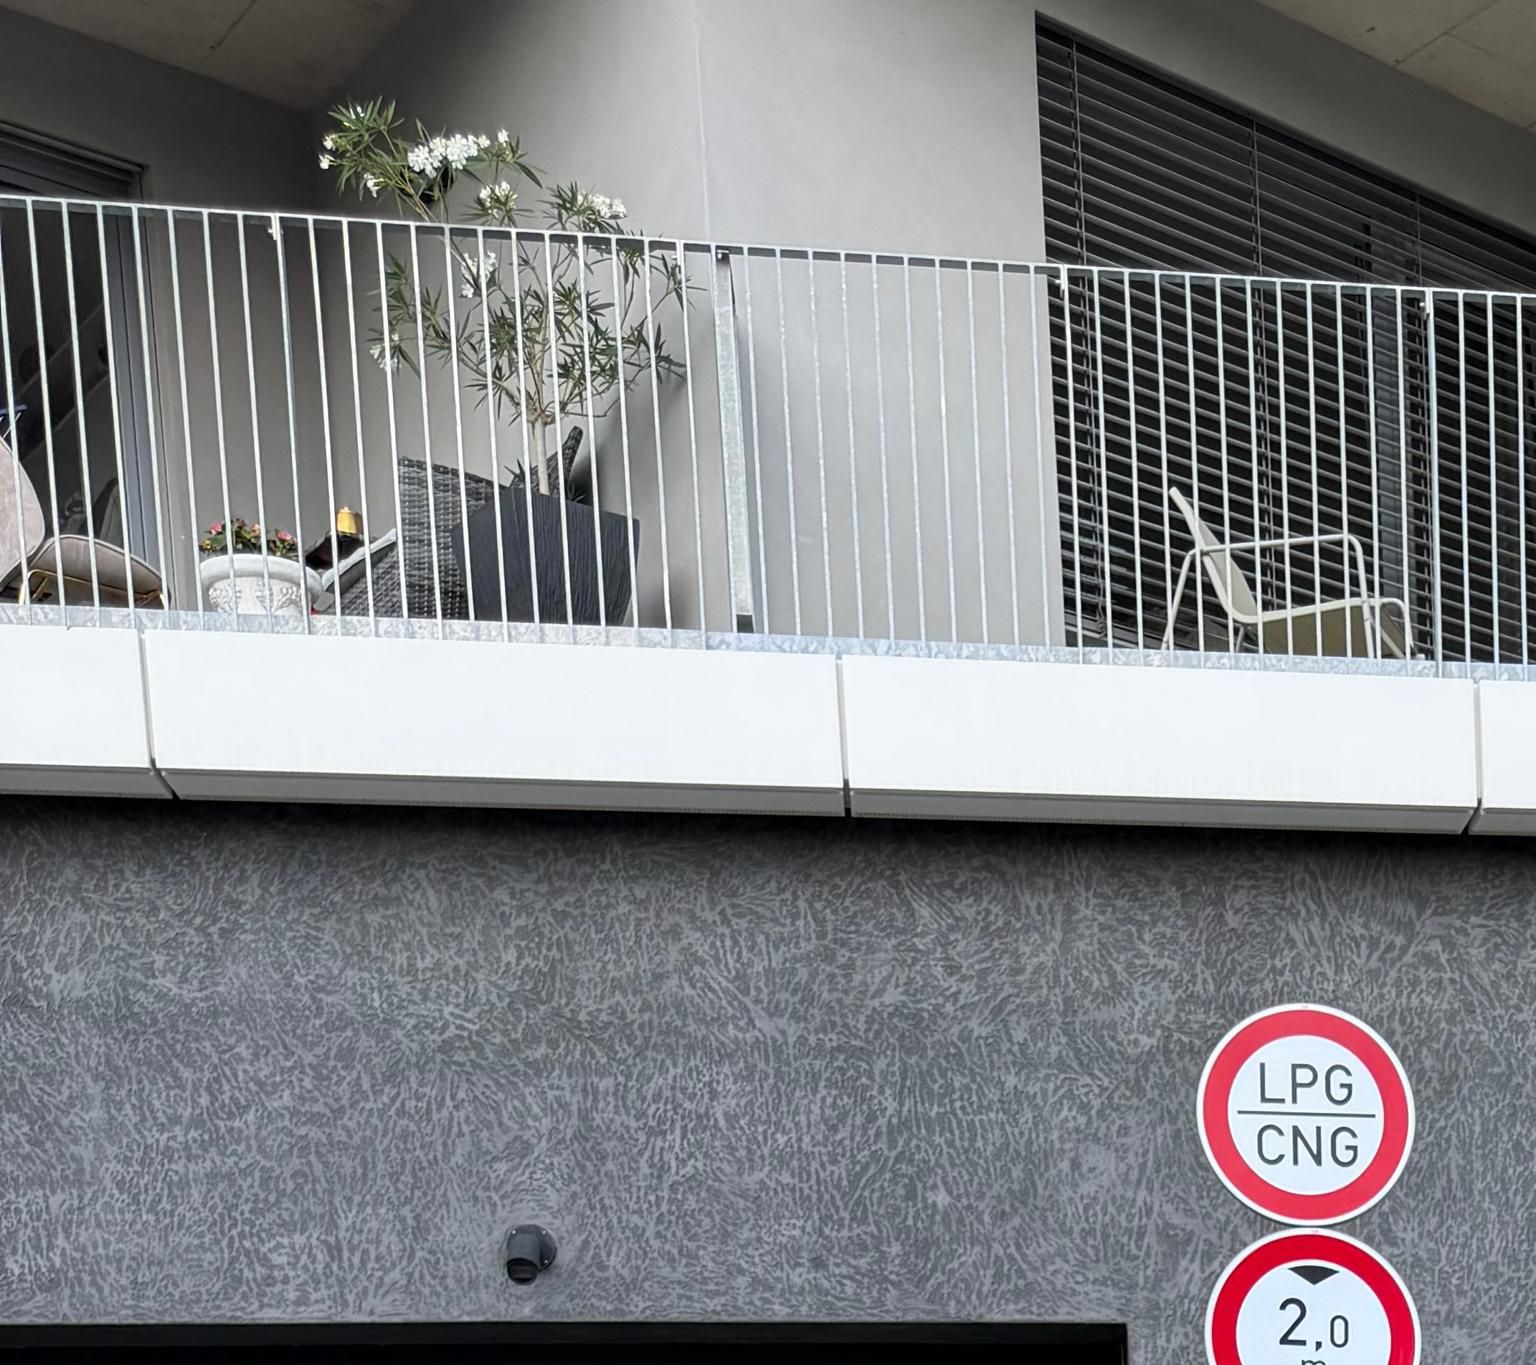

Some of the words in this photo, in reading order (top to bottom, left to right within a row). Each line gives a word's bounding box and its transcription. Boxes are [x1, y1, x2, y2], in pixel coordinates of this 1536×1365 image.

[1258, 1061, 1354, 1107] LPG
[1256, 1123, 1359, 1168] CNG
[1278, 1297, 1350, 1353] 2,0
